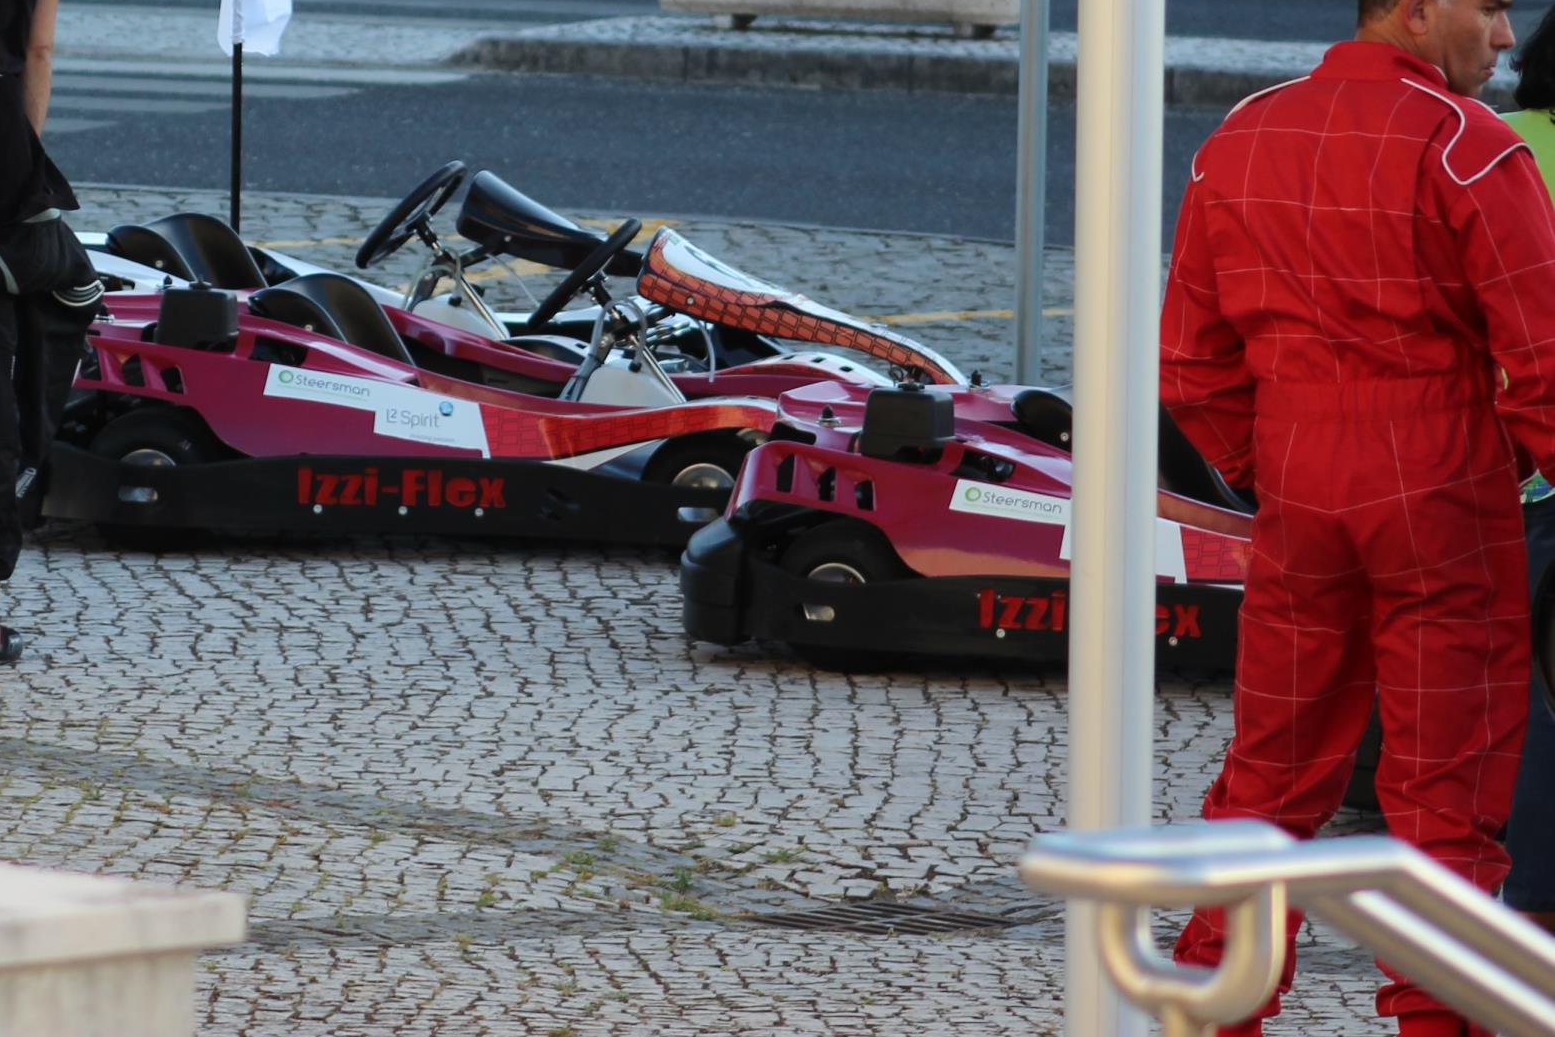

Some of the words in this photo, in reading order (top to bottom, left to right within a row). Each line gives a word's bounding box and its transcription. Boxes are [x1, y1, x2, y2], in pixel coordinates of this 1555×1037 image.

[294, 374, 371, 397] Steersman
[297, 466, 507, 509] Izzi-Flex
[982, 490, 1063, 515] Steersman
